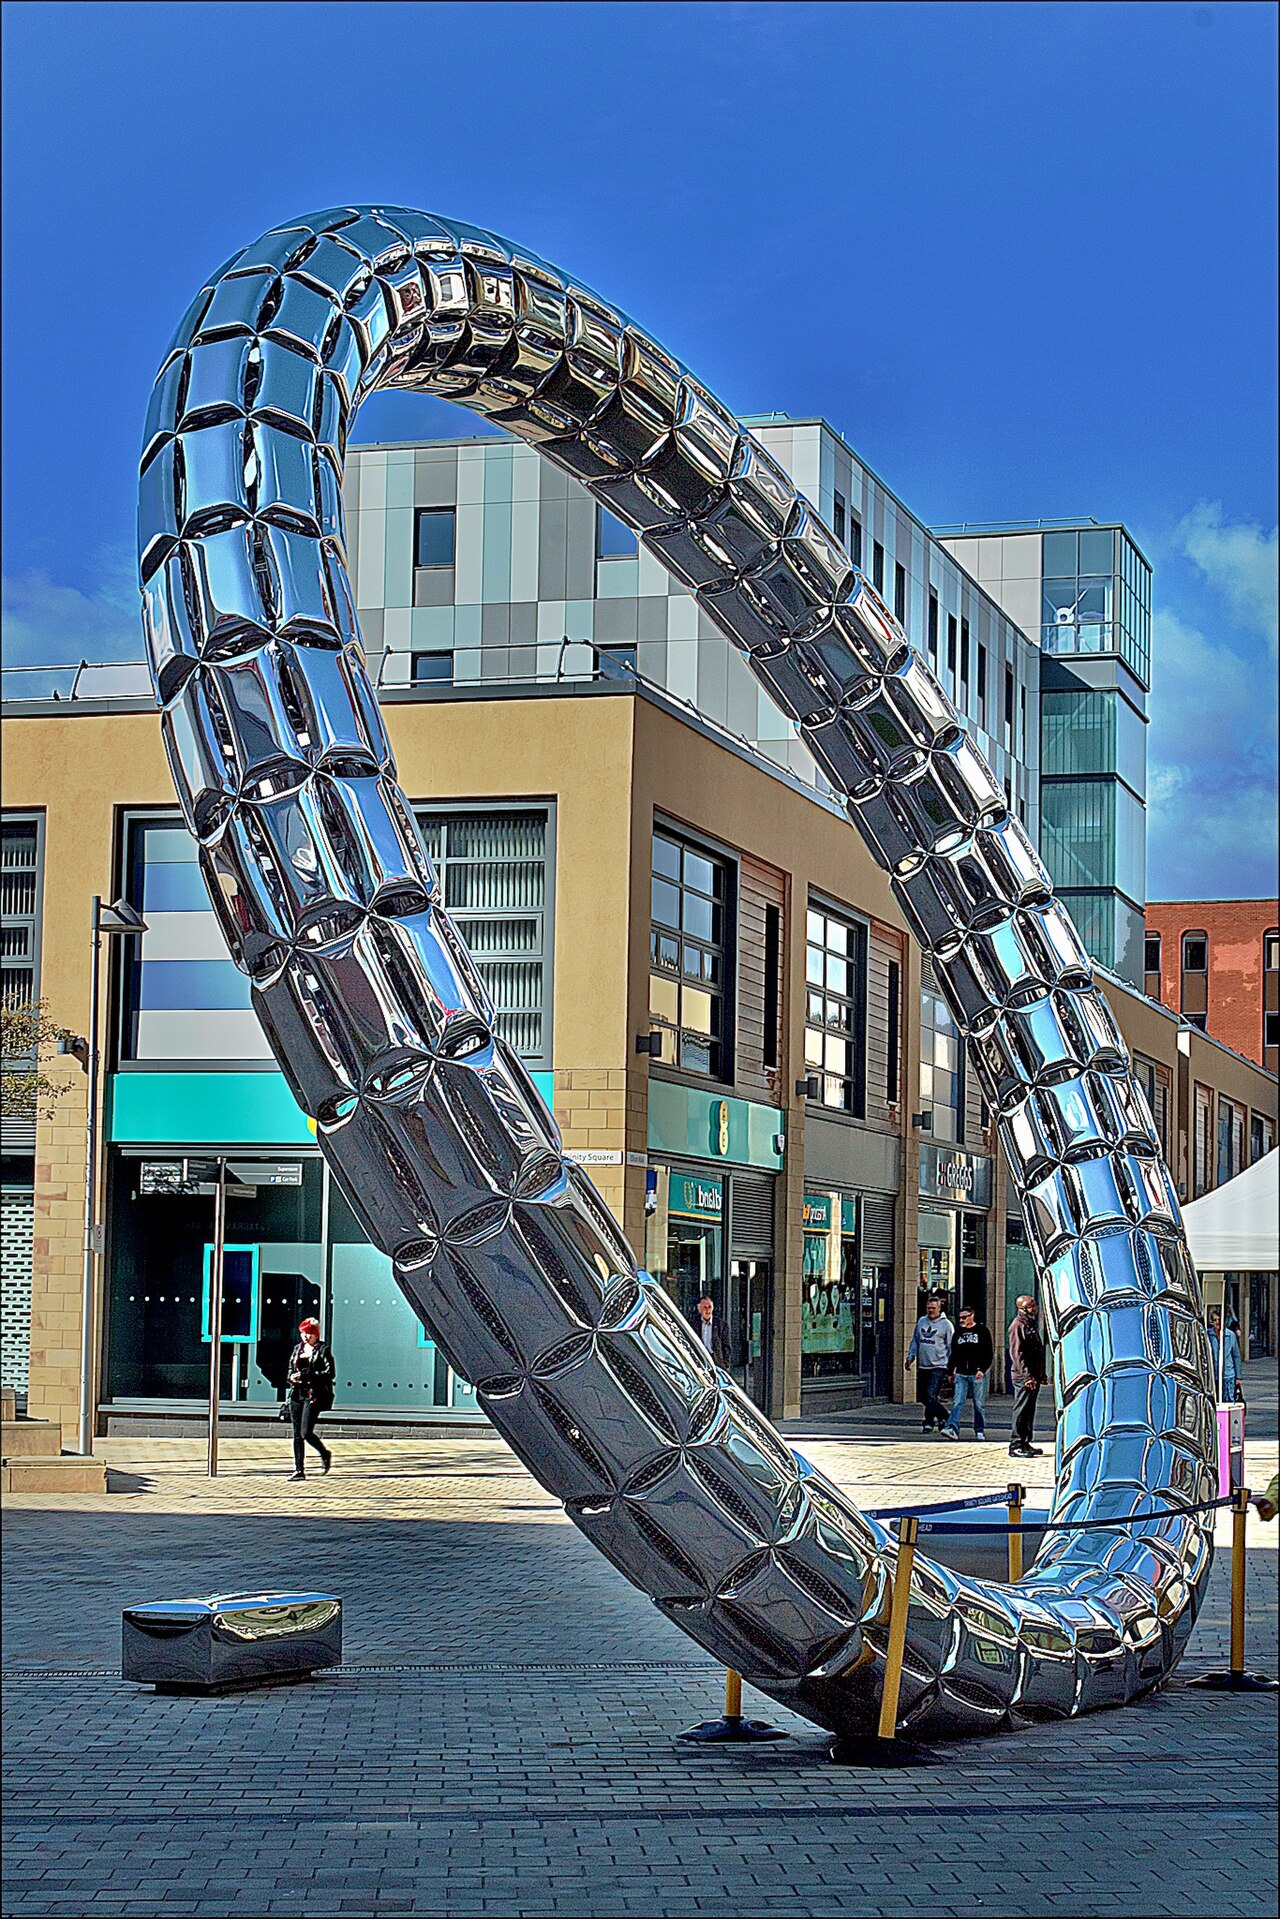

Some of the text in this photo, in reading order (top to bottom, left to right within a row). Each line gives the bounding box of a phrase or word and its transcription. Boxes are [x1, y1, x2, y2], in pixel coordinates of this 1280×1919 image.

[564, 1153, 614, 1162] rinity Square
[947, 1163, 972, 1191] GREGGS
